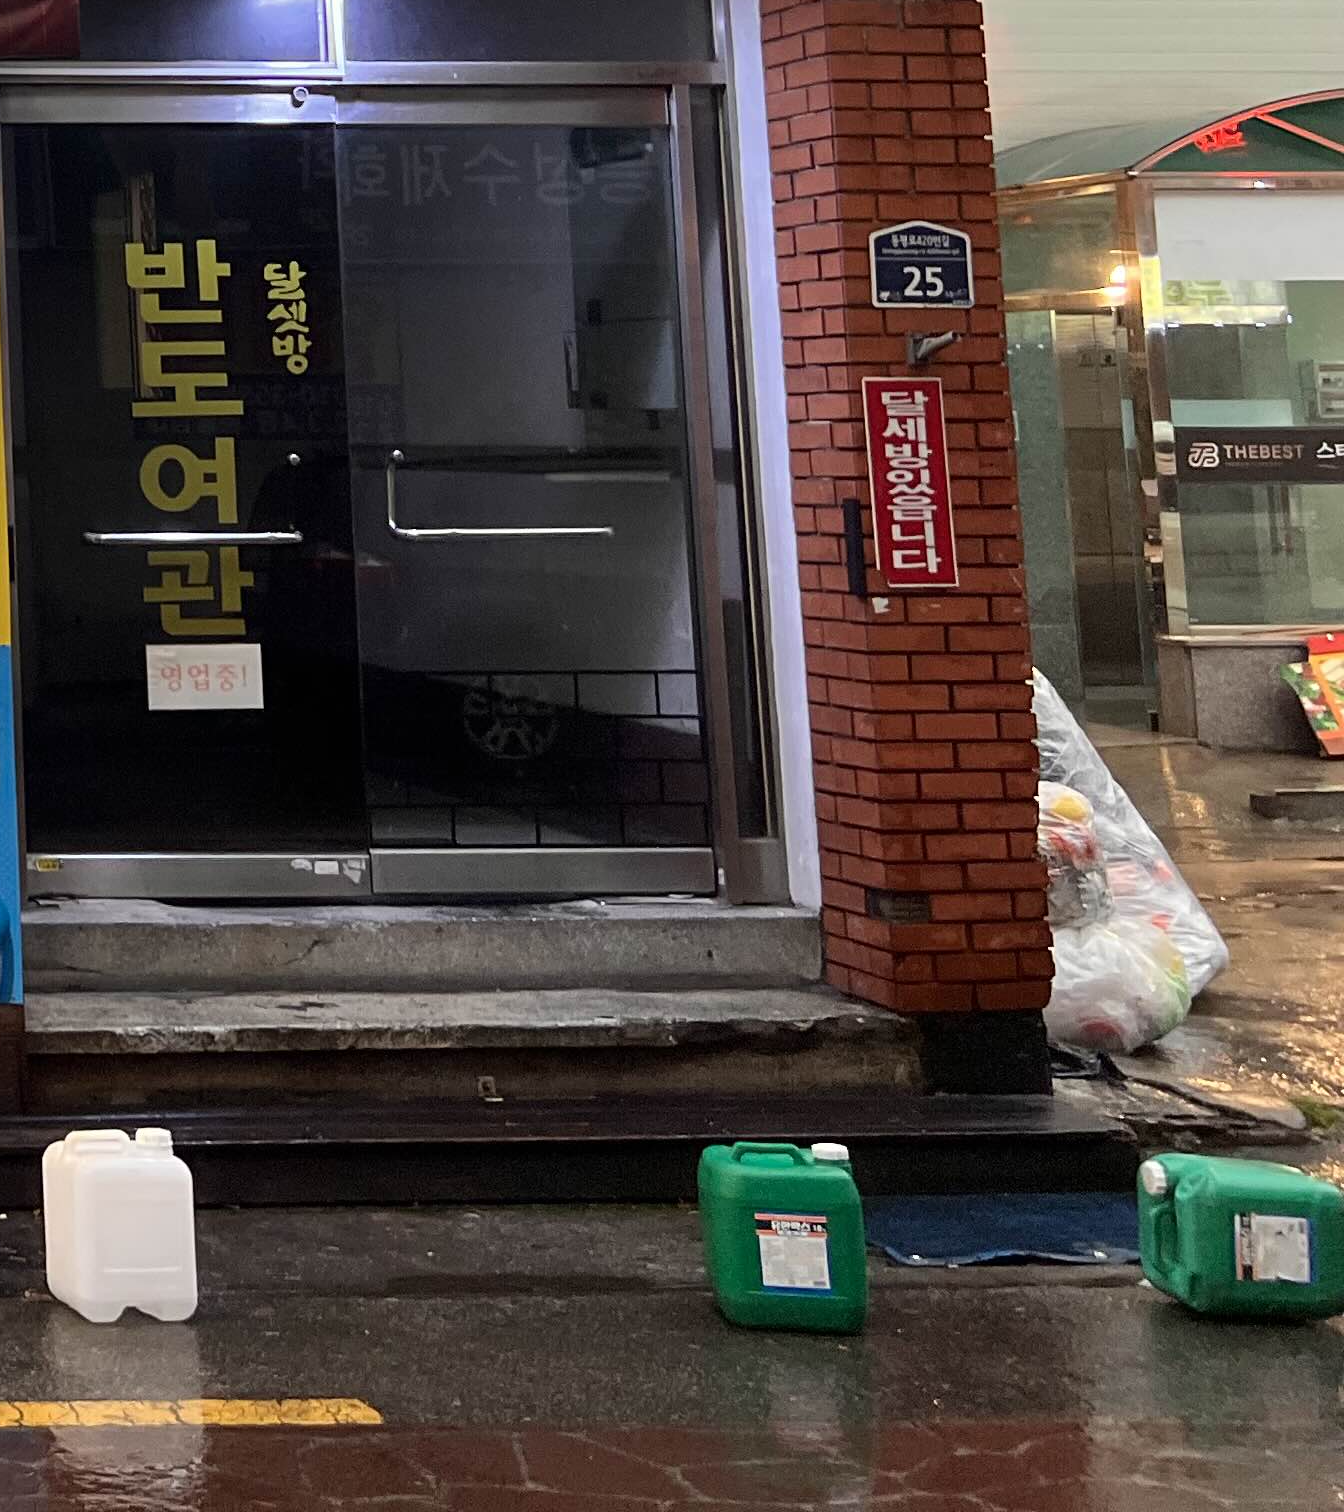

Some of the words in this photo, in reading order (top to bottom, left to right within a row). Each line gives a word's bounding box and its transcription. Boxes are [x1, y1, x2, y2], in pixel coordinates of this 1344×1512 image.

[263, 260, 313, 375] 달셋방
[903, 266, 944, 297] 25
[125, 239, 254, 636] 반도여관
[1223, 444, 1305, 459] THEBEST
